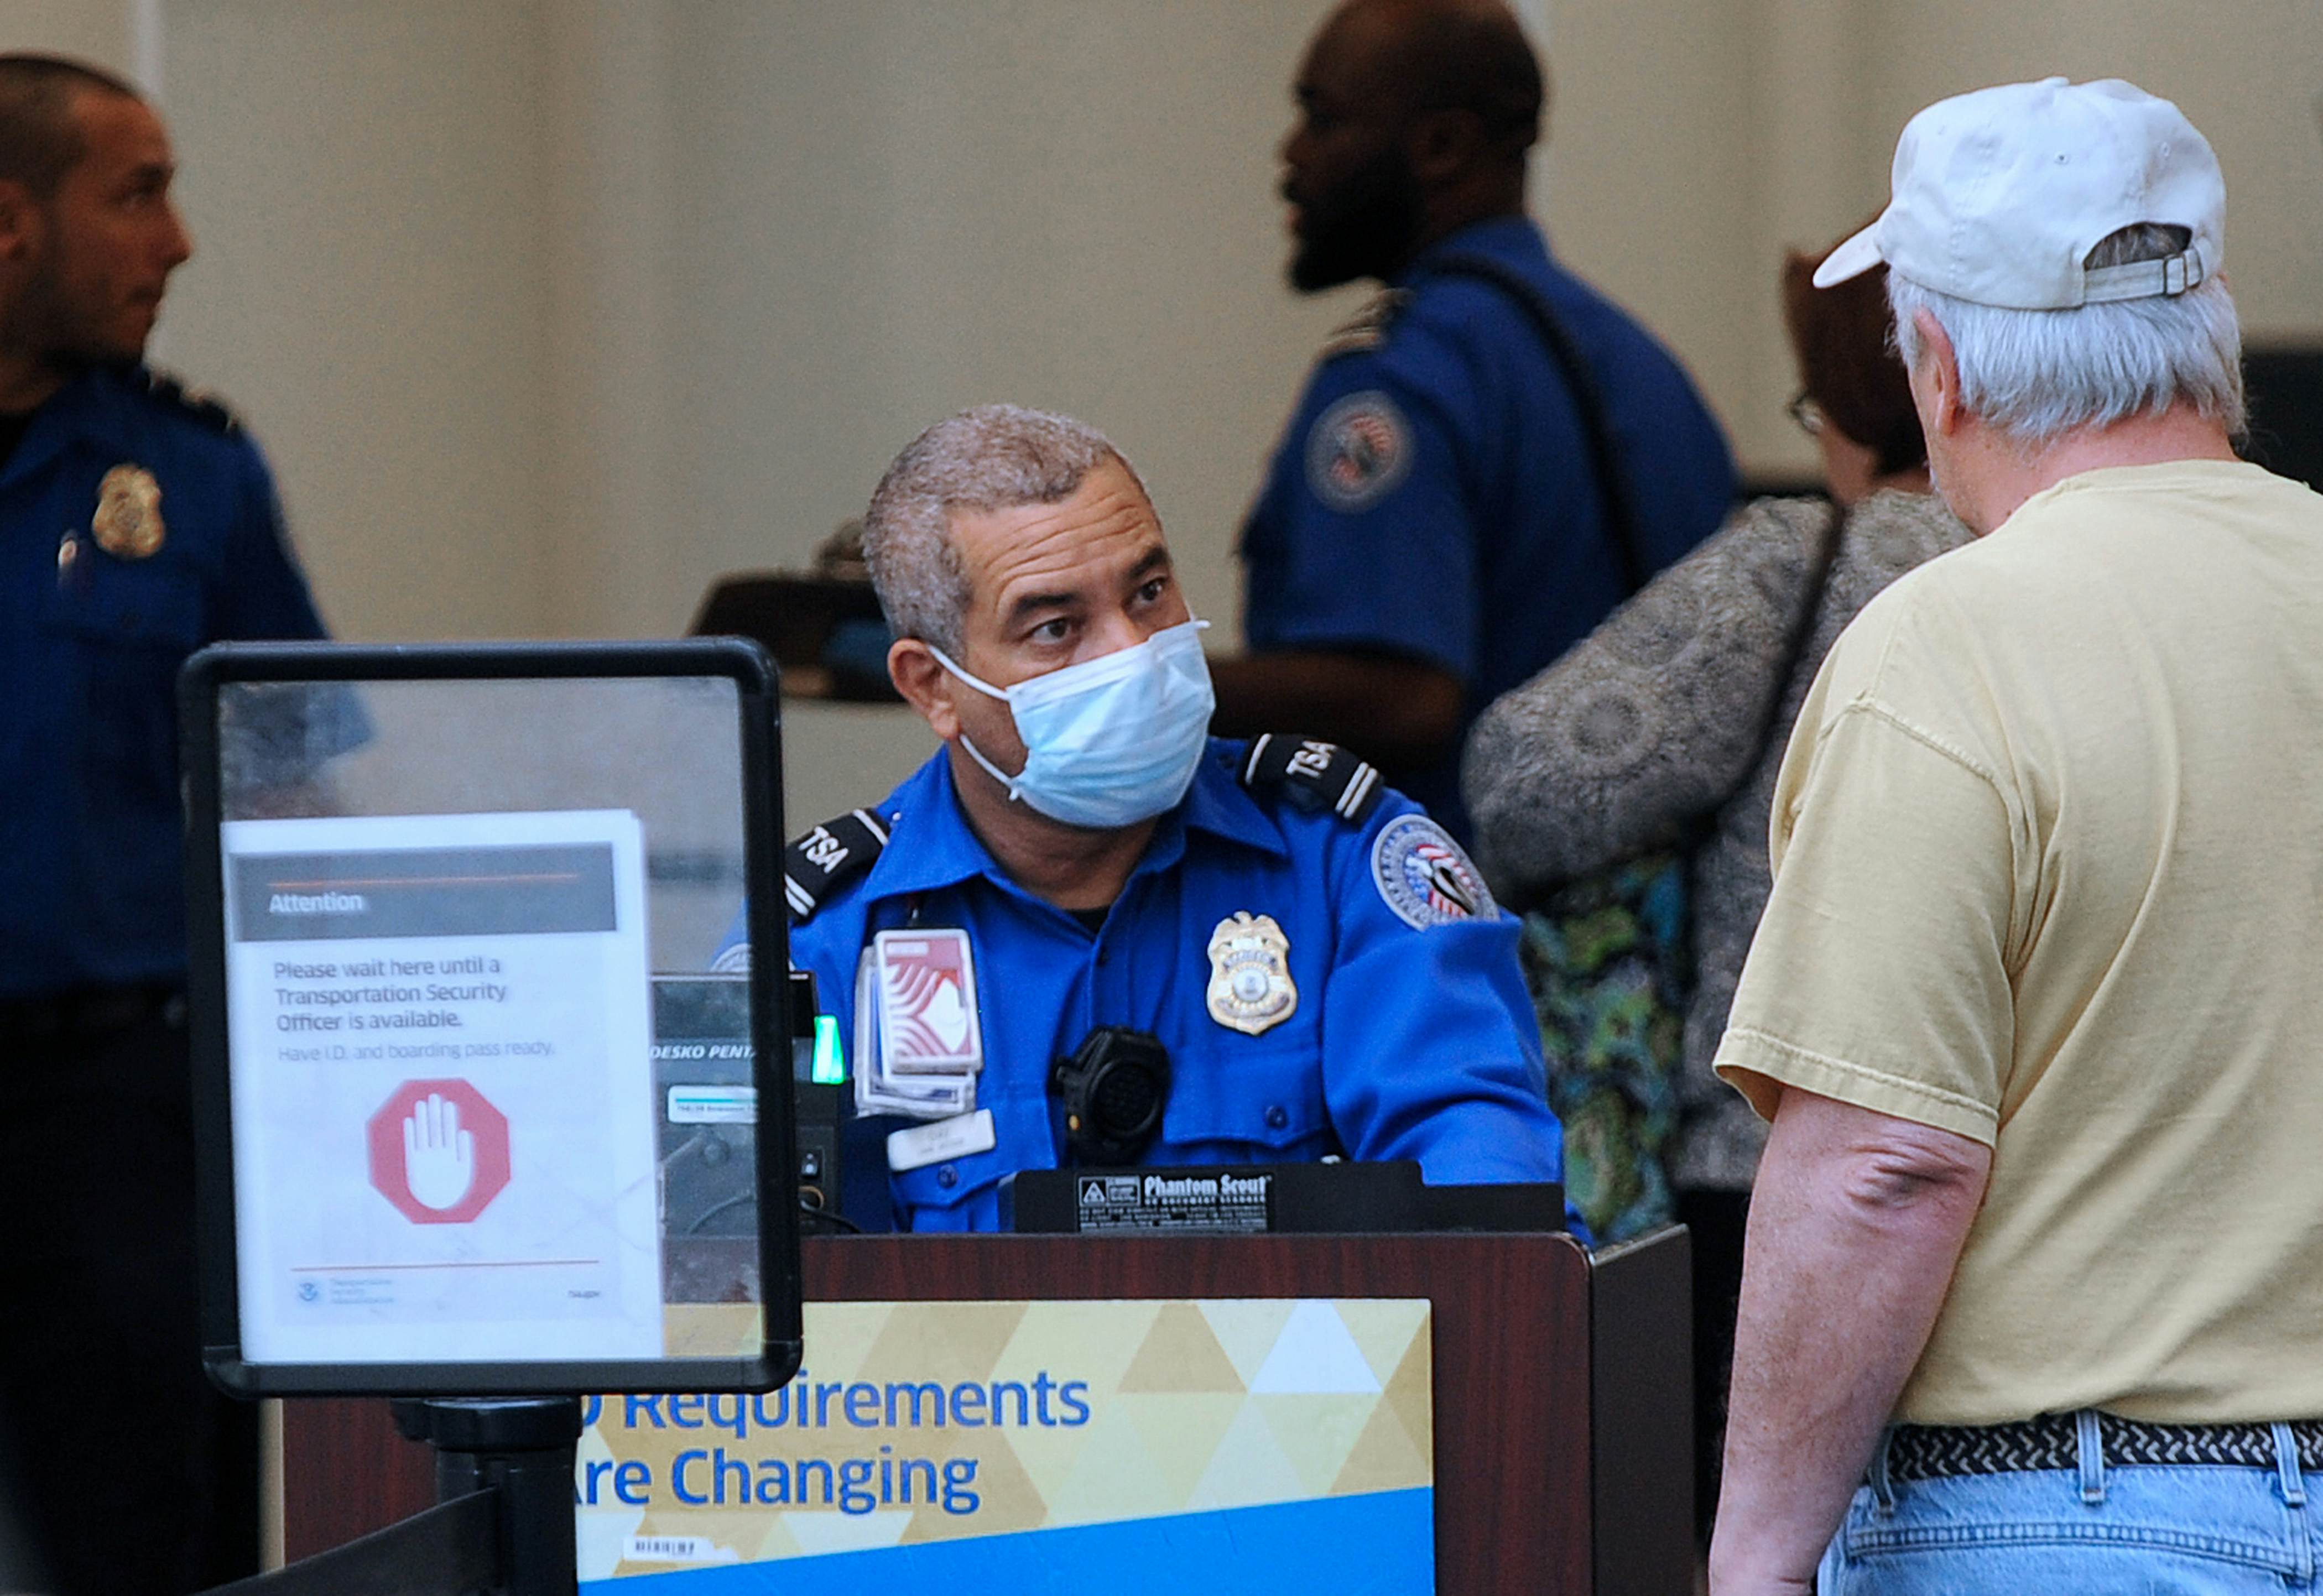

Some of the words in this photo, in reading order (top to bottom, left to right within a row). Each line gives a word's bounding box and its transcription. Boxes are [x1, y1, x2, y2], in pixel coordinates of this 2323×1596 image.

[1285, 740, 1337, 779] TSA
[798, 826, 850, 874] TSA
[269, 892, 365, 913] Attention
[274, 962, 337, 979] Please
[341, 960, 385, 977] wait
[390, 958, 435, 976] here
[440, 956, 484, 974] until
[488, 959, 502, 973] a
[275, 987, 420, 1006] Transportation
[426, 983, 507, 1002] Security
[277, 1014, 342, 1031] Officer
[349, 1014, 364, 1029] is
[369, 1011, 463, 1029] available.
[278, 1044, 321, 1061] Have
[352, 1044, 383, 1059] and
[388, 1042, 461, 1062] boarding
[465, 1042, 500, 1060] pass
[649, 1044, 705, 1059] DESKO
[1144, 1175, 1217, 1196] Phantom
[624, 1370, 1090, 1438] Requirements
[575, 1459, 652, 1505] re
[671, 1447, 981, 1515] Changing
